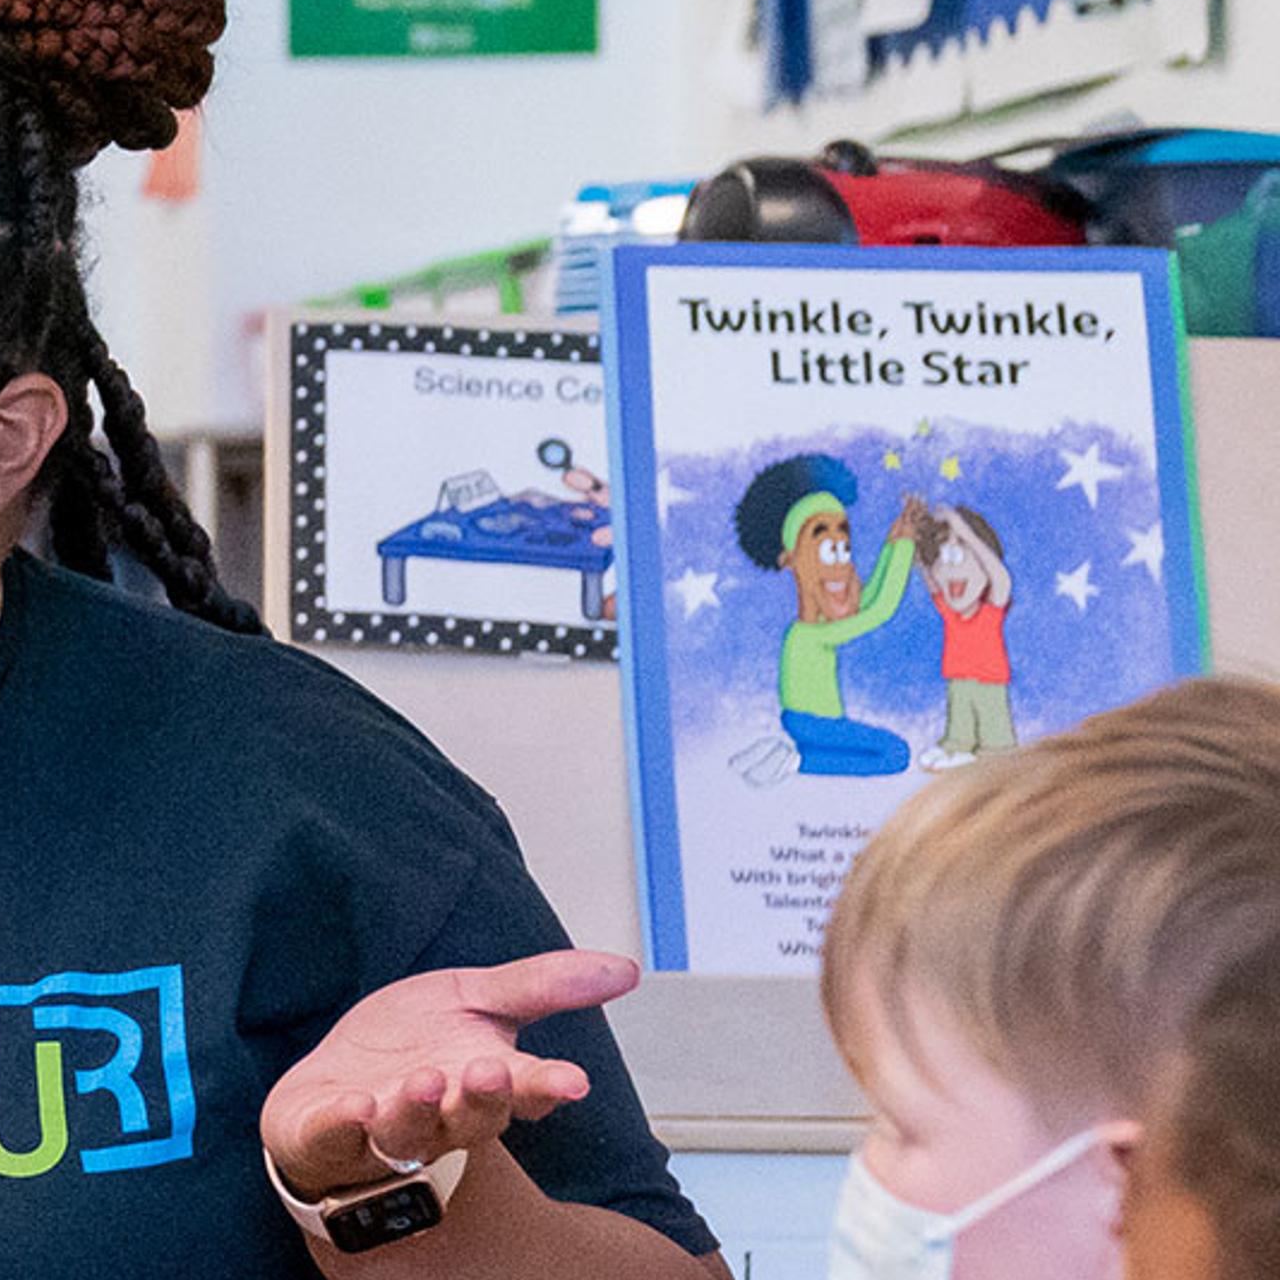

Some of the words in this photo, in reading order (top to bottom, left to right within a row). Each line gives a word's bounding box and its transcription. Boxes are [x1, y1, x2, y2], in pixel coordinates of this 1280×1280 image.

[679, 298, 889, 341] Twinkle,
[902, 301, 1116, 343] Twinkle,
[413, 365, 544, 400] Science
[770, 348, 905, 386] Little
[922, 349, 1030, 387] Star
